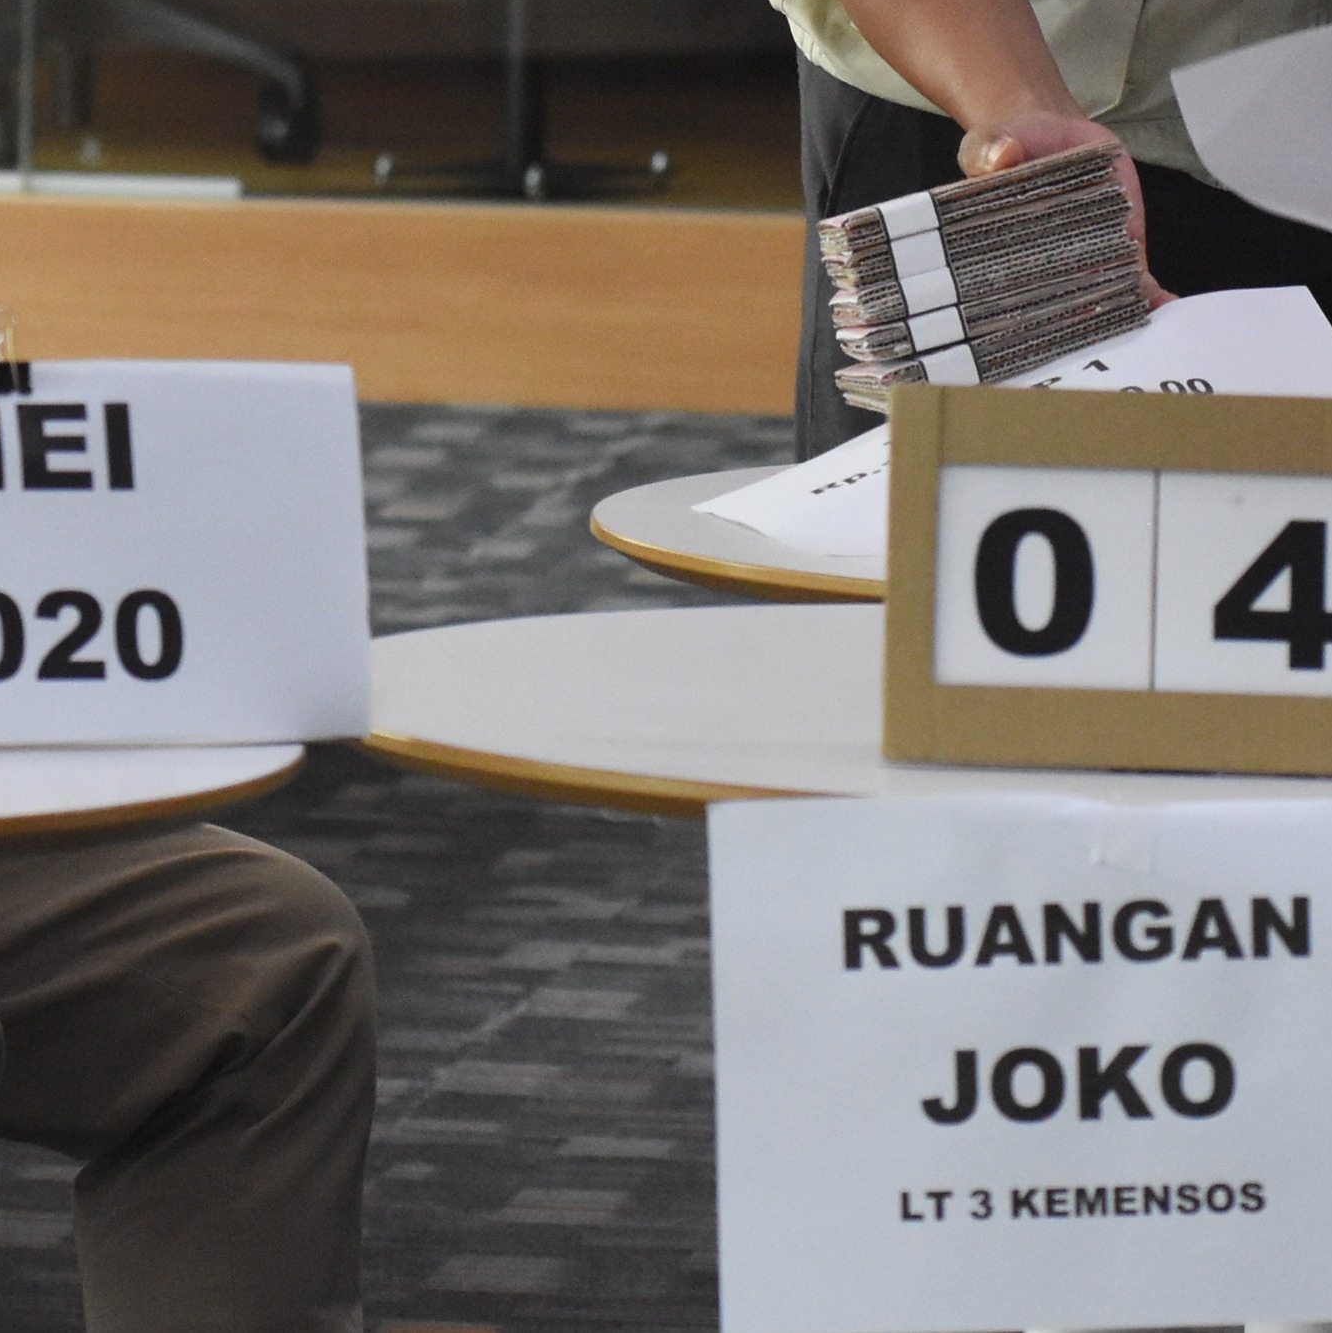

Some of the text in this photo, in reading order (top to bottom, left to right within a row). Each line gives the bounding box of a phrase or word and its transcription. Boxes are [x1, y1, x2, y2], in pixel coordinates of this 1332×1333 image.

[842, 896, 1312, 971] RUANGAN
[921, 1041, 1236, 1126] JOKO
[900, 1182, 1267, 1222] LT 3 KEMENSOS
